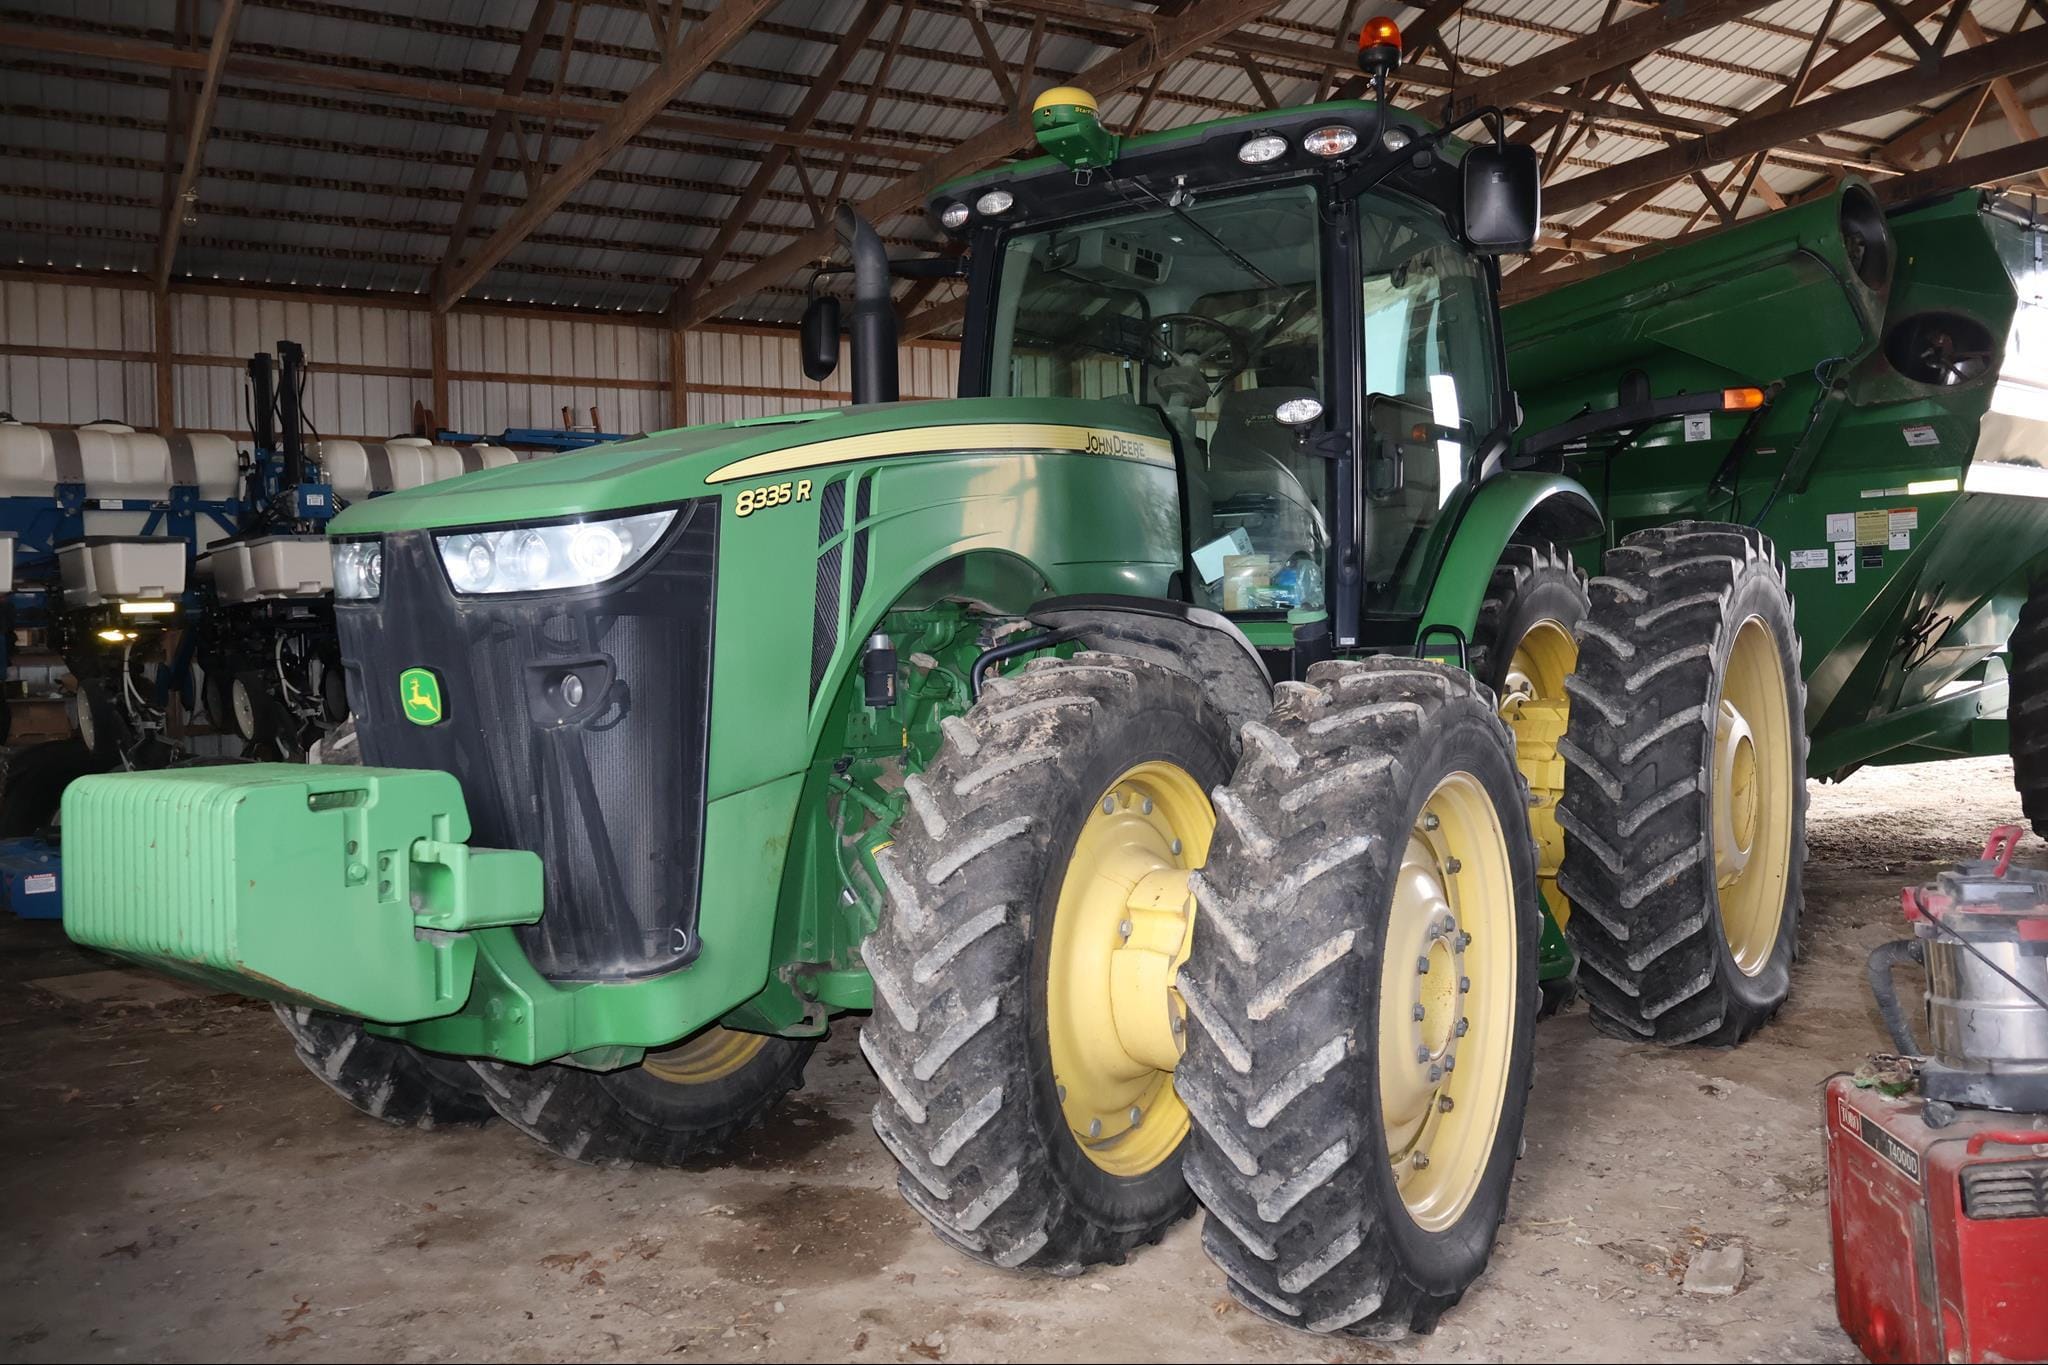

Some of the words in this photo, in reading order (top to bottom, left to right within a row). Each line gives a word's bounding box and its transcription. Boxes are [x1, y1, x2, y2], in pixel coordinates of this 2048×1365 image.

[1085, 432, 1113, 453] JOHN
[1113, 435, 1145, 457] DEERE
[735, 482, 792, 517] 8335
[796, 480, 812, 502] R
[1887, 1139, 1917, 1174] T4000D
